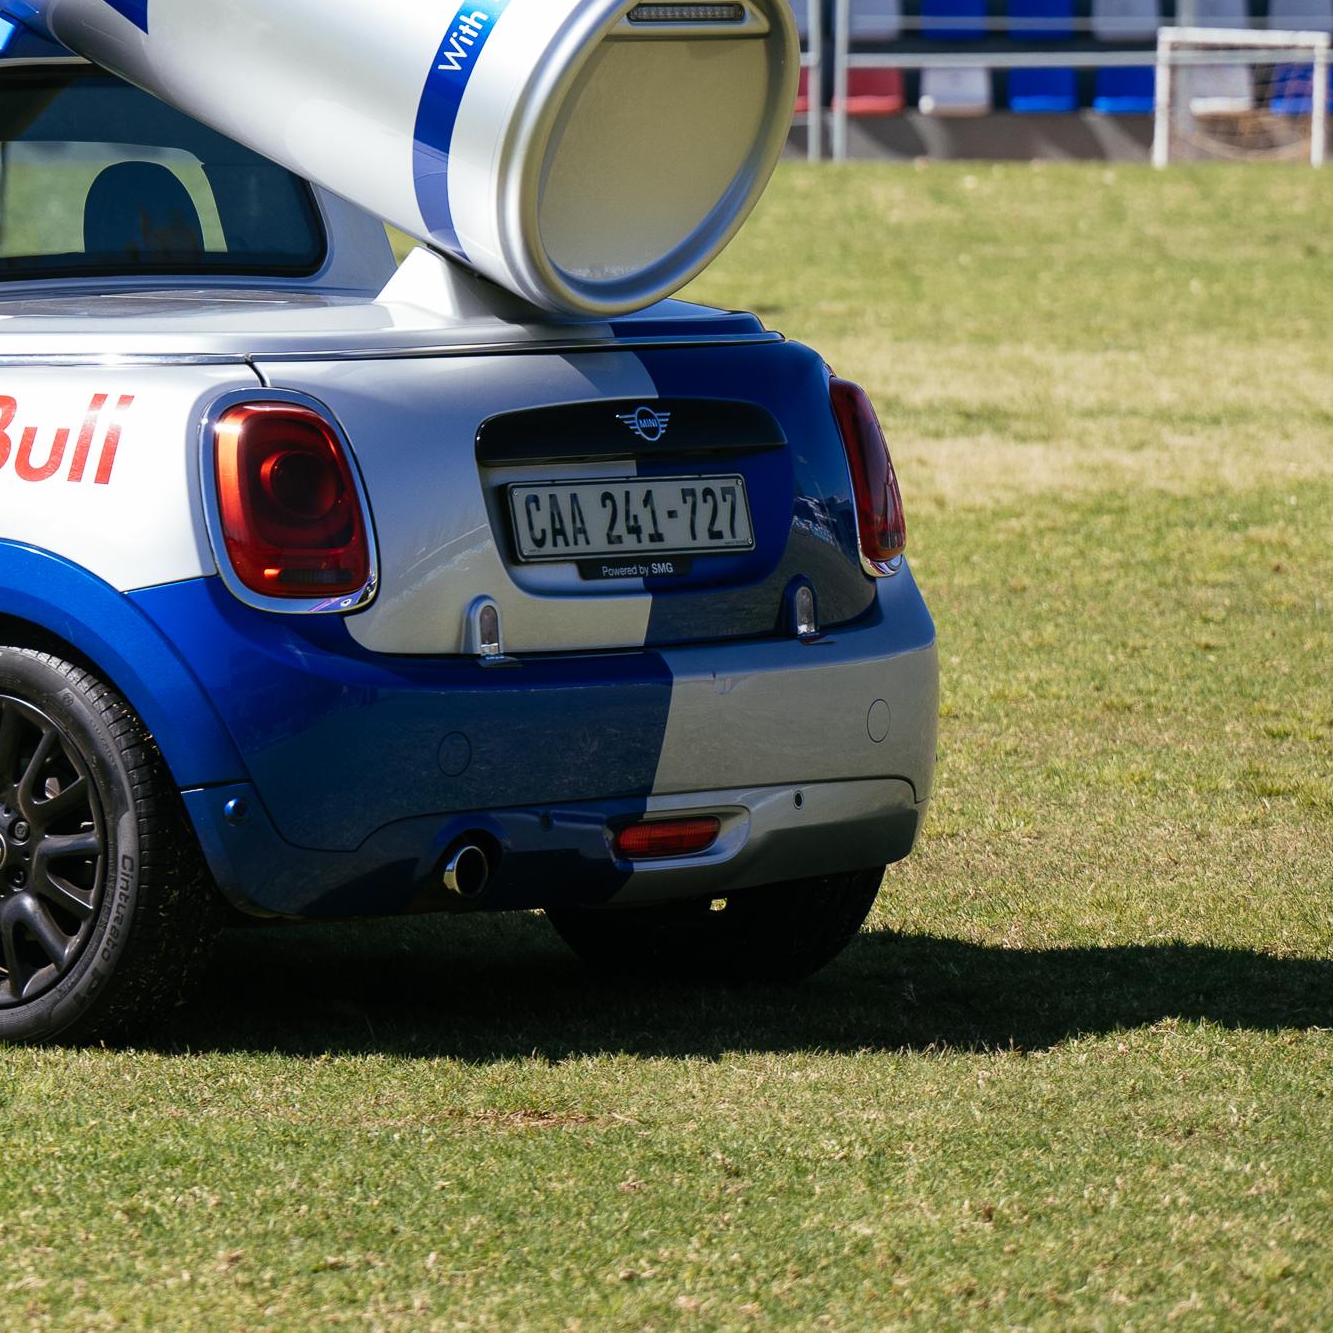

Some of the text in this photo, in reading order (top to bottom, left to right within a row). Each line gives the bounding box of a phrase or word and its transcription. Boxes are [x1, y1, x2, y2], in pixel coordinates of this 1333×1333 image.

[438, 9, 488, 72] With
[639, 418, 658, 428] MINI
[524, 486, 739, 549] CAA 241-727
[602, 562, 674, 577] Powered by SMG
[101, 854, 134, 962] Cinturato
[73, 967, 105, 1008] P1
